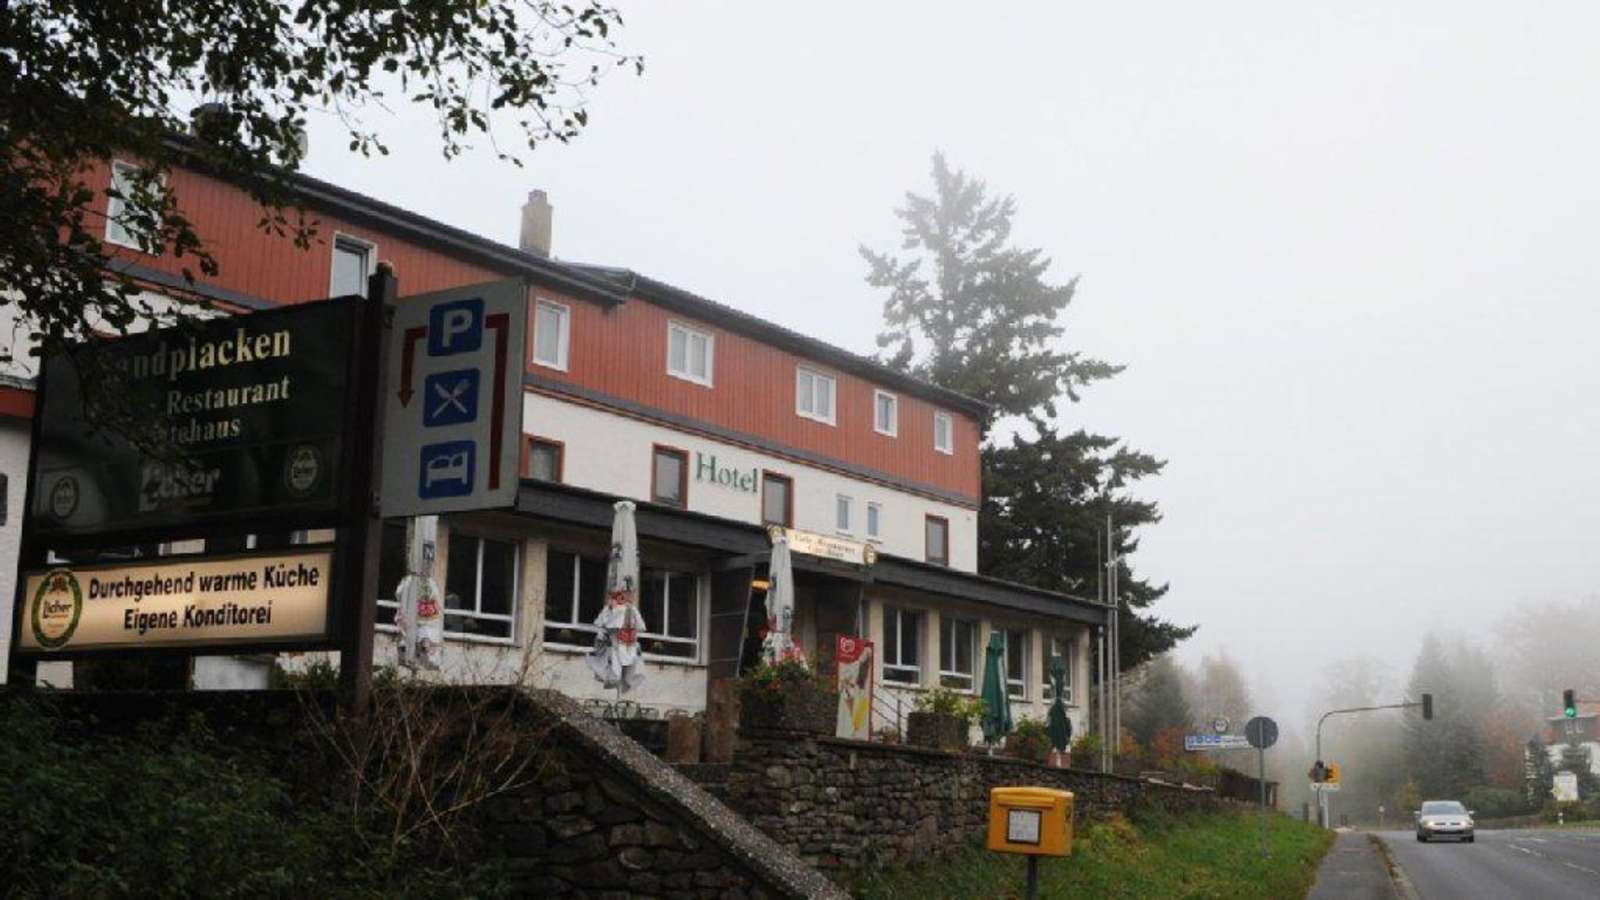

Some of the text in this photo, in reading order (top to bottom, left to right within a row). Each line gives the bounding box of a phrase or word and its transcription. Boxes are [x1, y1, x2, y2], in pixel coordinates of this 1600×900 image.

[441, 308, 473, 348] P
[104, 328, 291, 381] ndplacken
[166, 375, 291, 415] Restaurant
[150, 416, 241, 446] tehaus
[696, 451, 758, 494] Hotel
[88, 563, 320, 602] Durchgehend warme Küche
[124, 600, 273, 636] Eigene Konditorei
